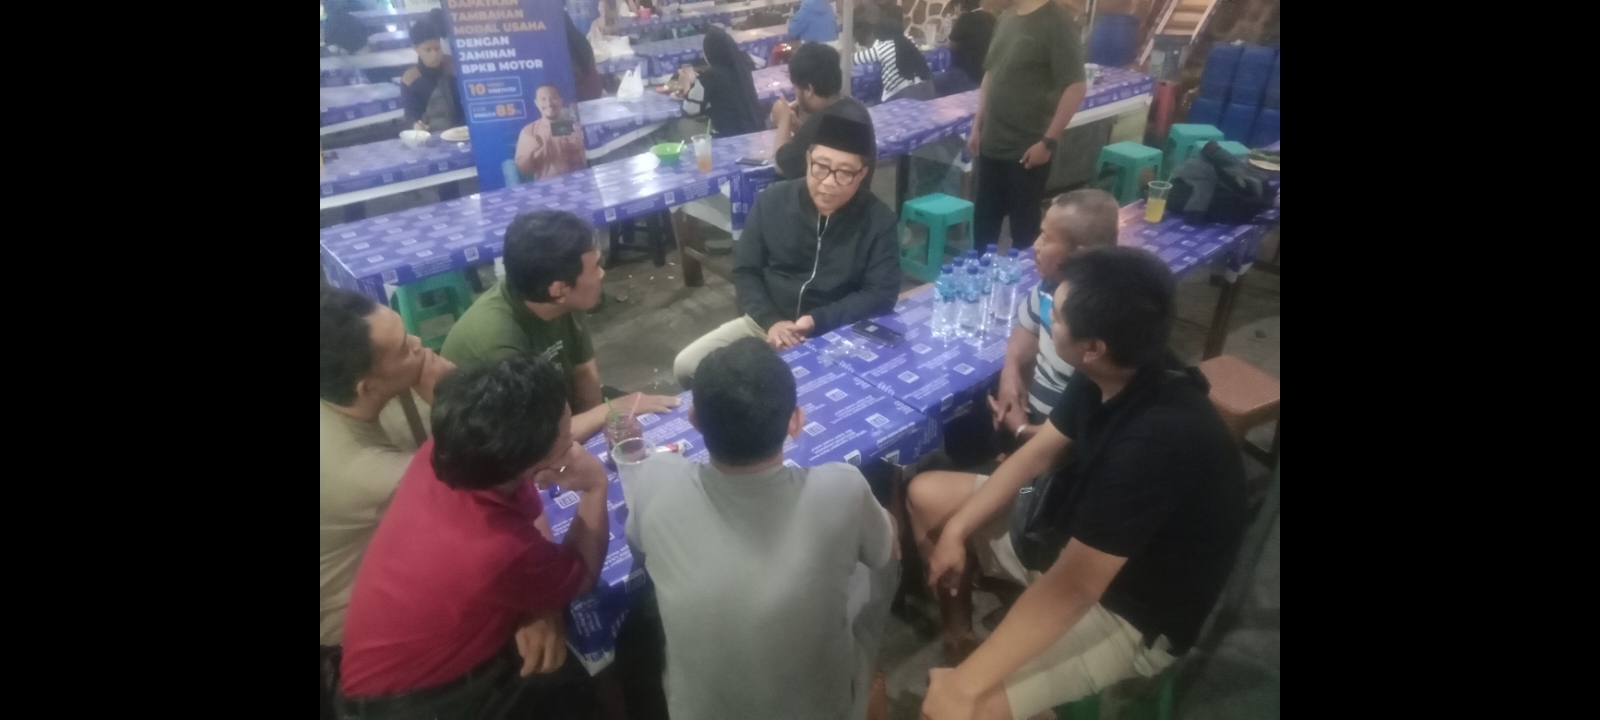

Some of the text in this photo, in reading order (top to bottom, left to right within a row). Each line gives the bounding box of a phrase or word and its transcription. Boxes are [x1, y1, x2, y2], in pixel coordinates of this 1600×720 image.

[450, 10, 523, 21] TAMBAHAN
[454, 21, 546, 35] MODAL USAHA
[456, 36, 510, 48] DENGAN
[459, 48, 516, 61] JAMINAN
[461, 59, 543, 74] BPKB MOTOR
[469, 83, 486, 95] 10
